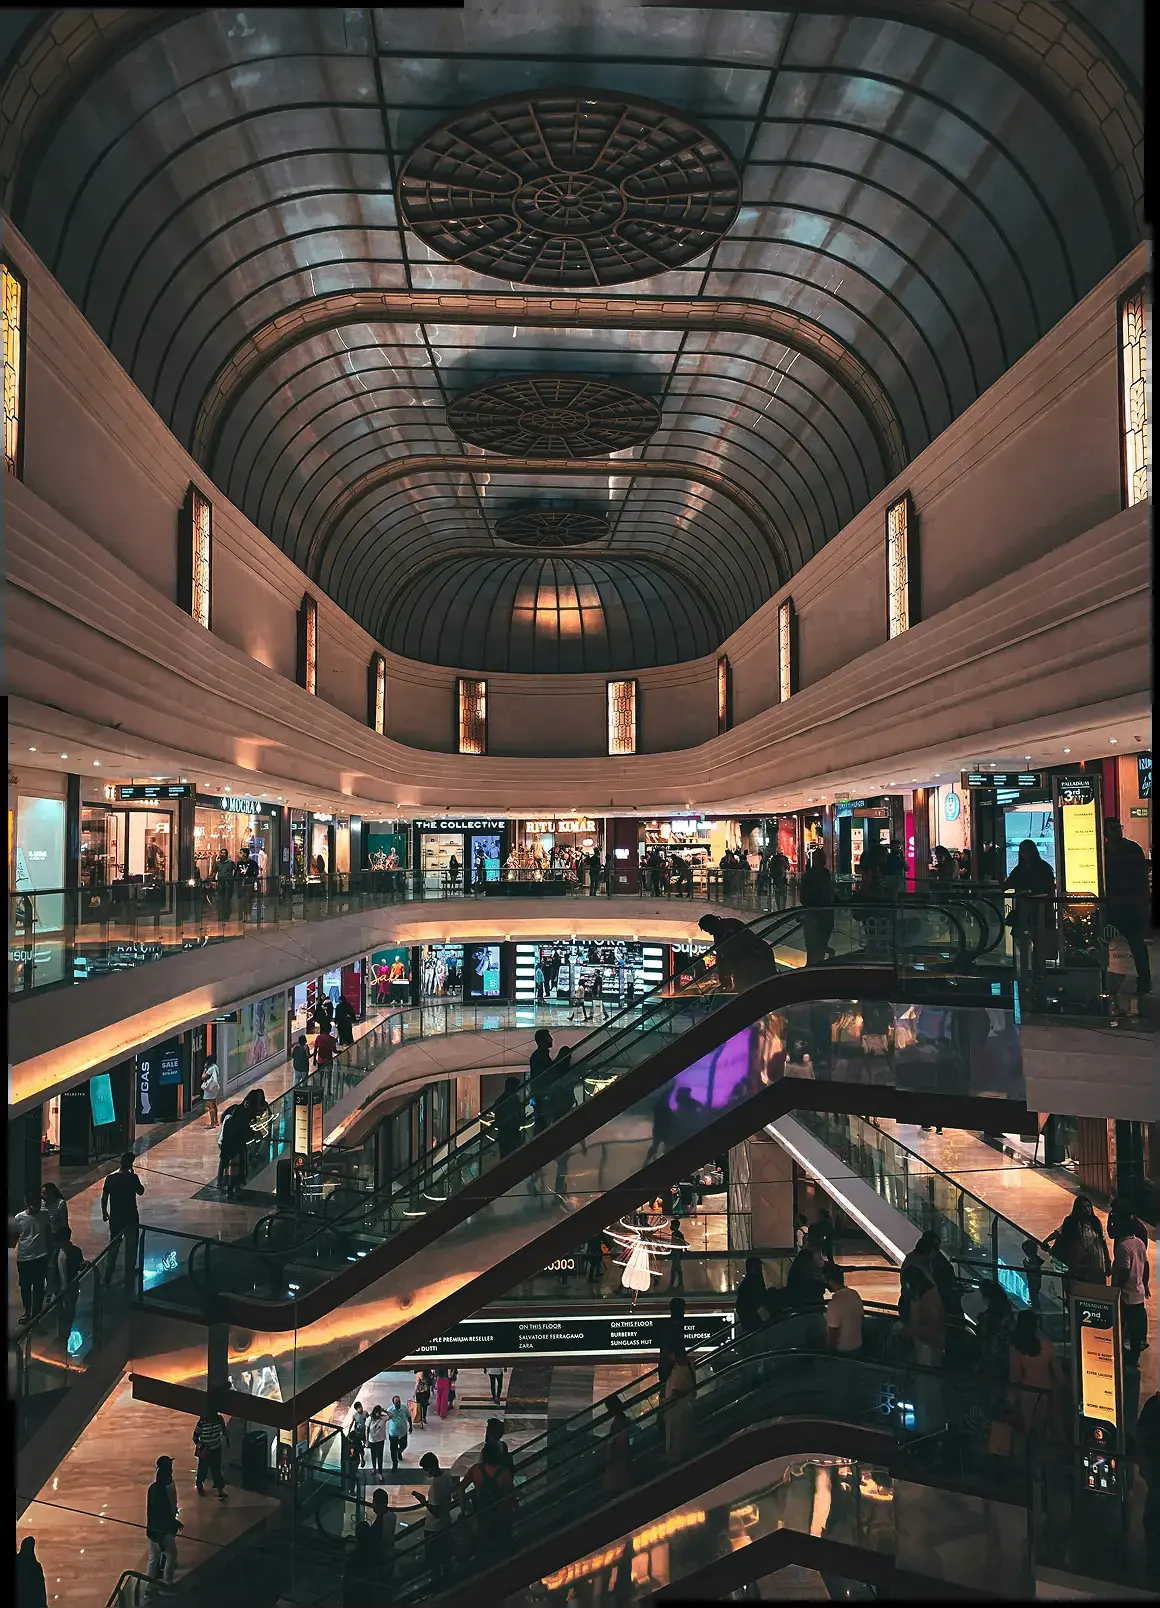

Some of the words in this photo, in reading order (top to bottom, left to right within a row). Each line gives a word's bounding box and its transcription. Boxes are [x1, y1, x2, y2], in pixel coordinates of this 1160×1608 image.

[1064, 790, 1080, 801] 3rd
[229, 798, 255, 814] MOGRA
[141, 1062, 150, 1092] GAS
[1083, 1310, 1100, 1323] 2nd
